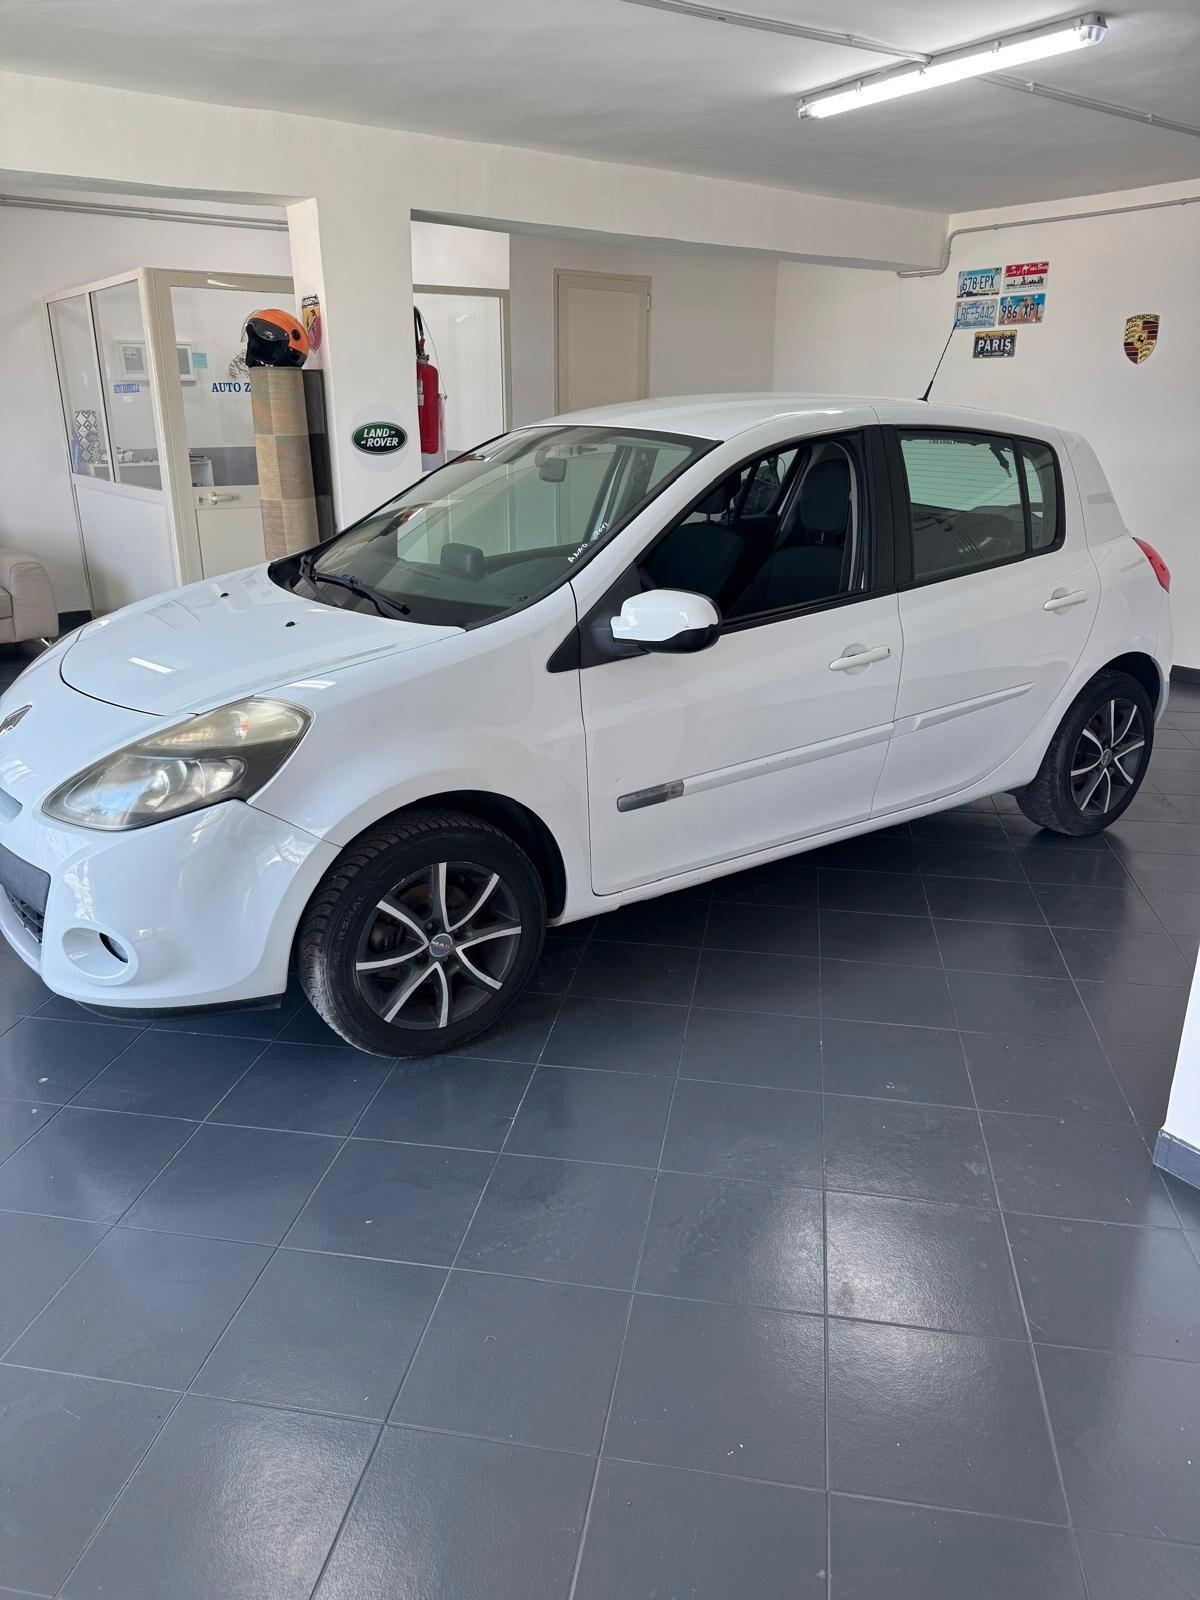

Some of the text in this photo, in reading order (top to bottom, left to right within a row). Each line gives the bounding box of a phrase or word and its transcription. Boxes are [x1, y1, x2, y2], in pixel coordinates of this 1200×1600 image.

[1001, 304, 1018, 320] 986
[978, 338, 1011, 352] PARIS
[211, 382, 242, 393] AUTO
[363, 428, 390, 438] LAND
[366, 437, 399, 447] ROVER
